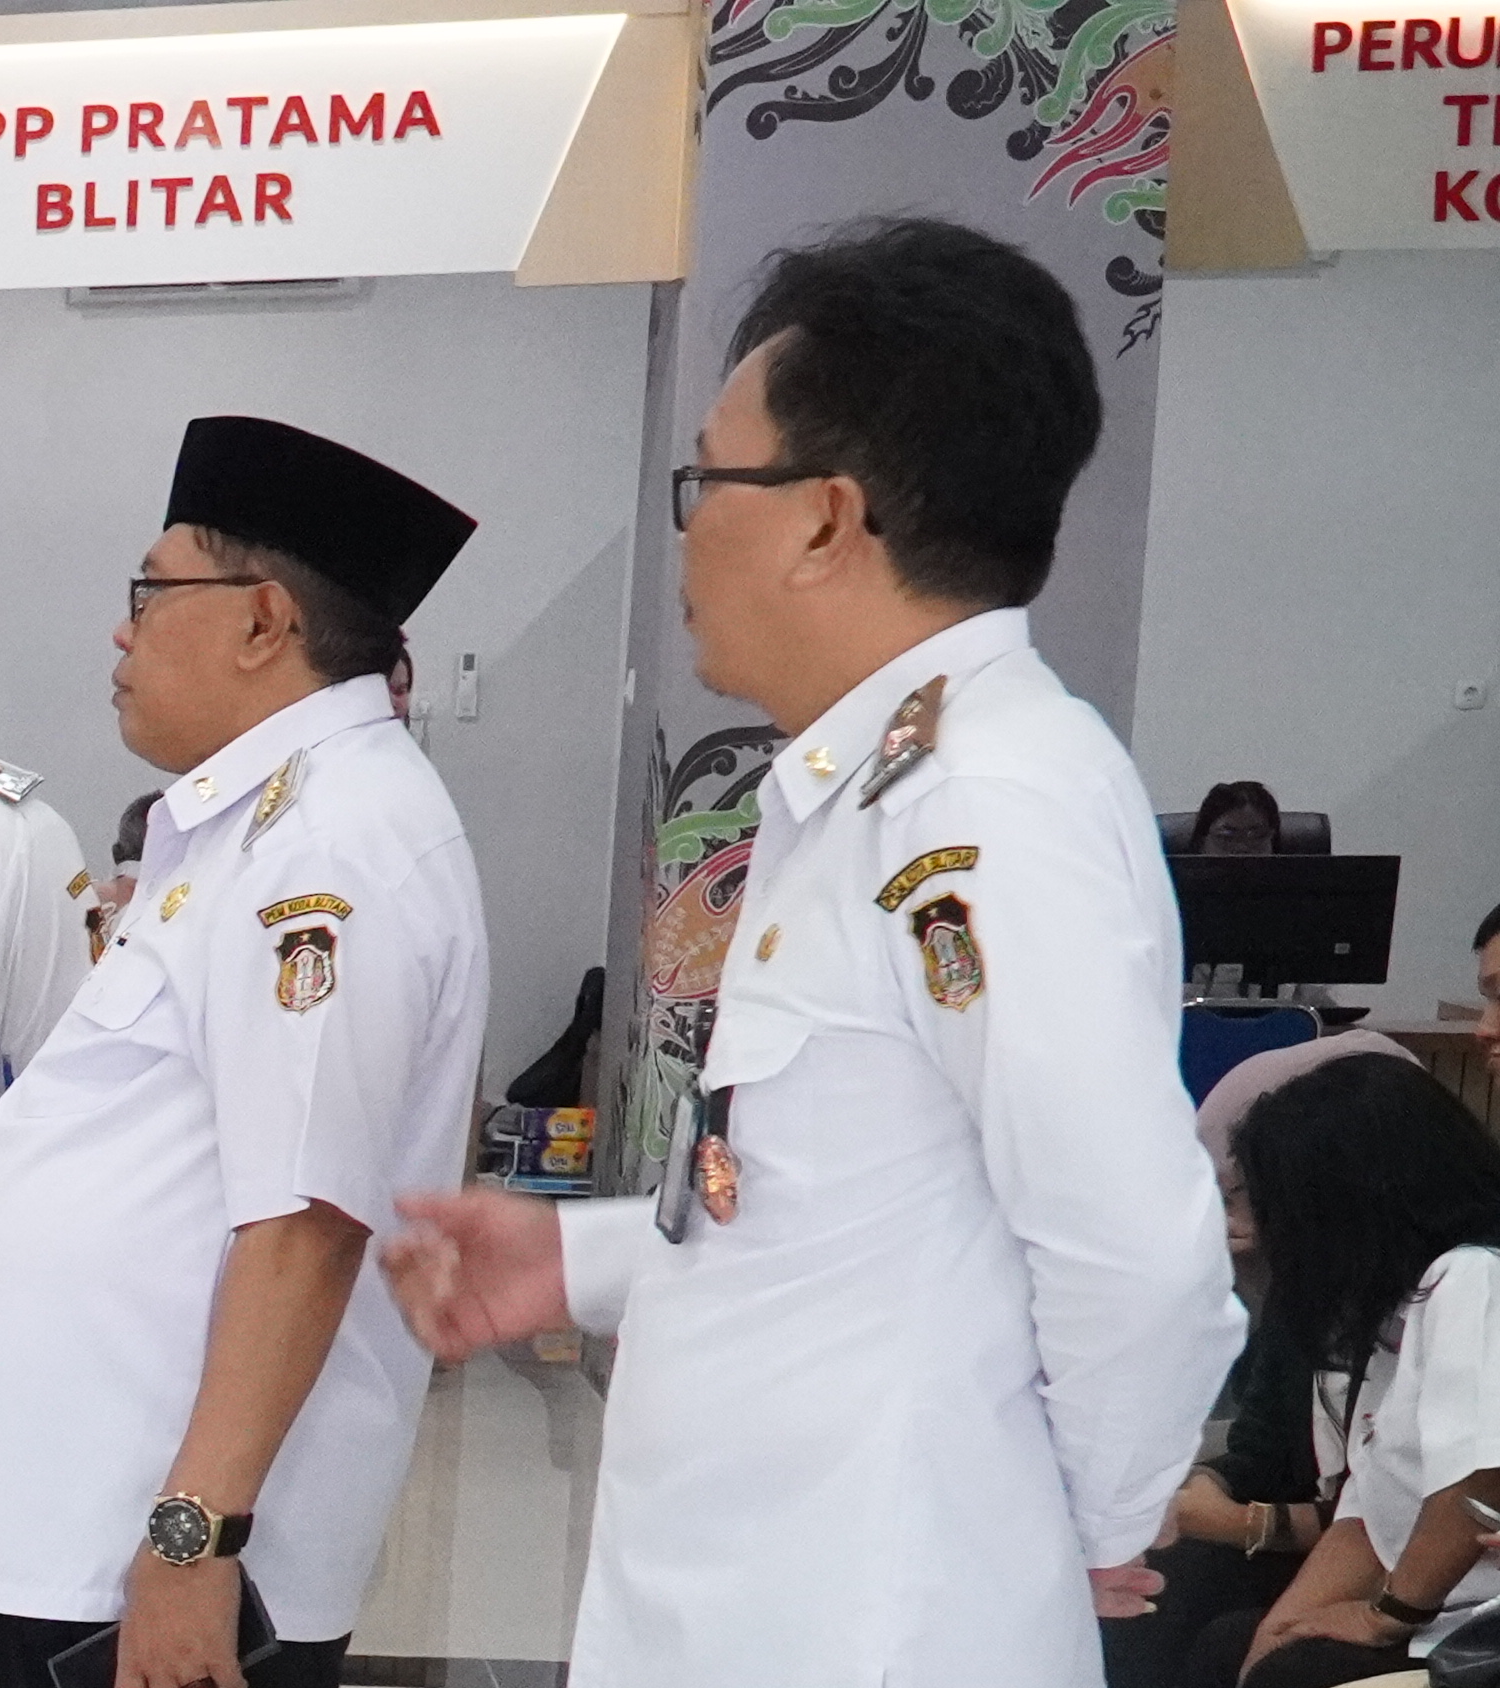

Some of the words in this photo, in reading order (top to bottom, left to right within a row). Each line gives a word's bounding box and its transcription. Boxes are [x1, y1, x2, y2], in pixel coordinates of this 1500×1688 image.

[1310, 15, 1500, 74] PERU
[81, 89, 442, 152] PRATAMA
[36, 172, 293, 229] BLITAR
